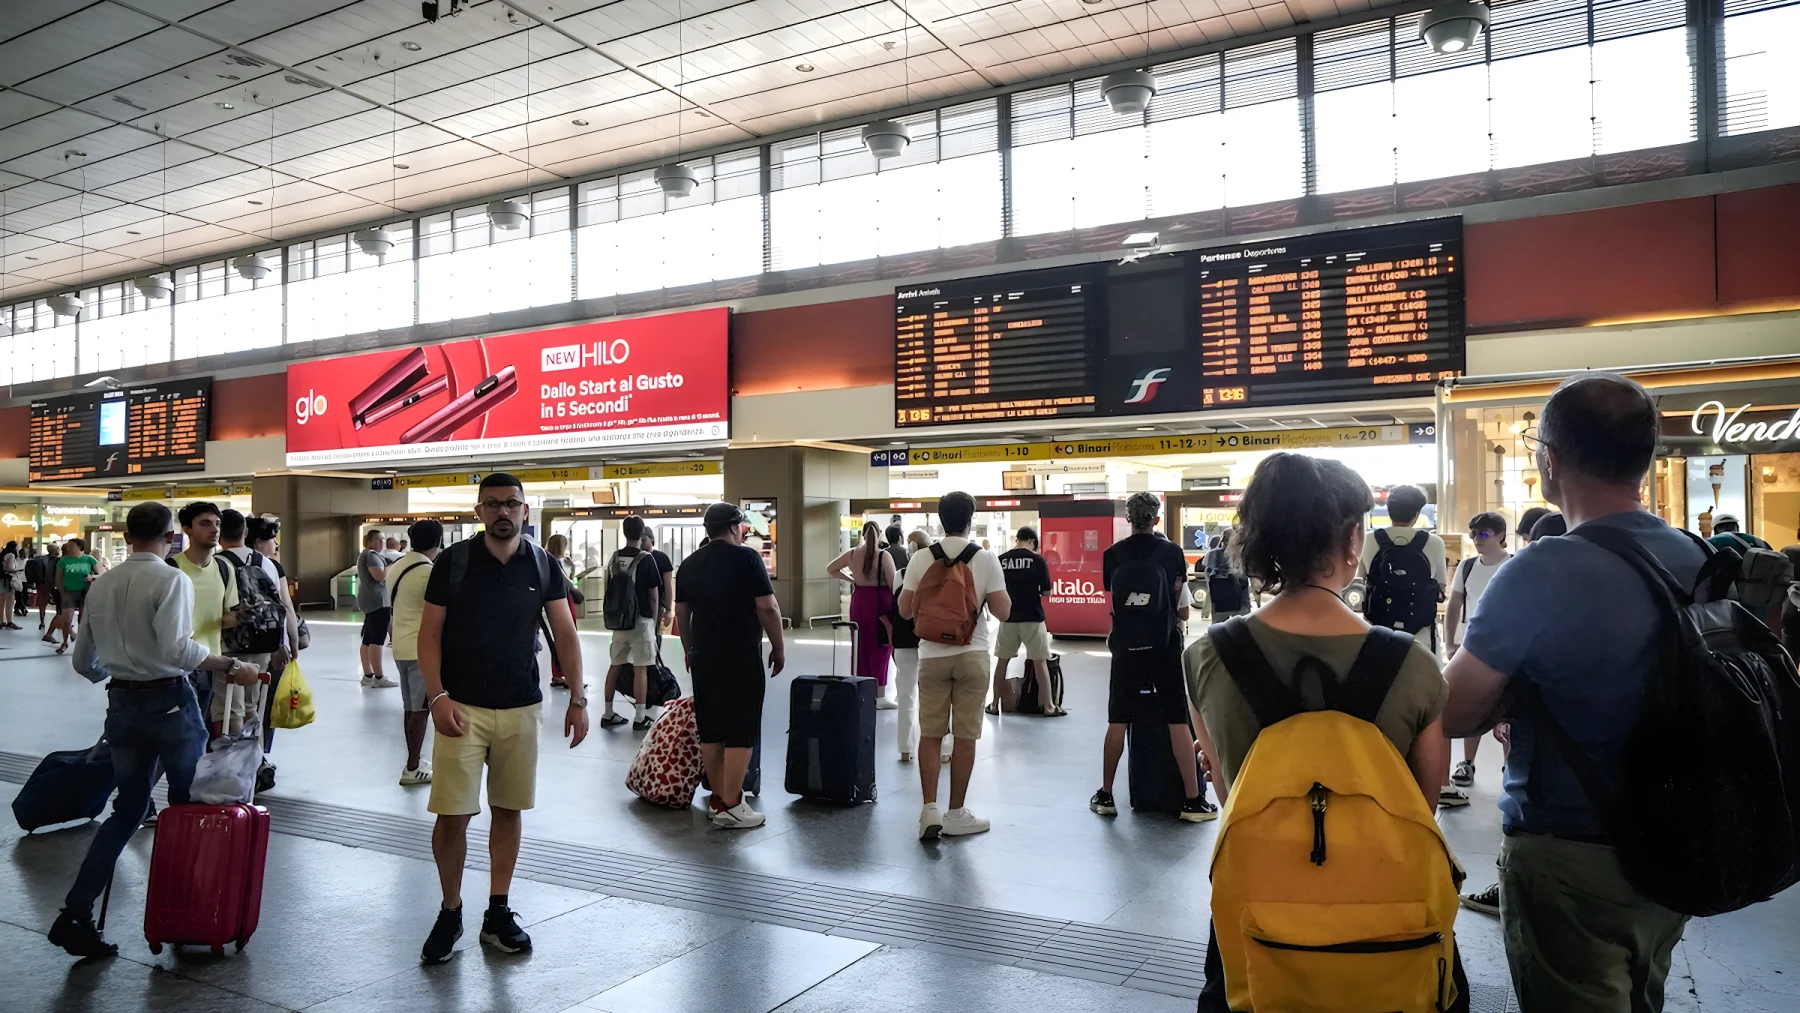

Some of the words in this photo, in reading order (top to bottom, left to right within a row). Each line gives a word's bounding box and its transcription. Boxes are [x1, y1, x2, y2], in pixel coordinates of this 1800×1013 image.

[545, 350, 576, 367] NEW
[582, 338, 630, 367] HILO
[541, 381, 576, 400] Dallo
[579, 376, 616, 396] Start
[619, 374, 633, 393] al
[636, 371, 684, 391] Gusto
[295, 388, 328, 425] glo
[541, 402, 554, 419] in
[556, 402, 566, 417] 5
[1077, 443, 1111, 453] Binari
[1242, 434, 1281, 446] Binari
[1004, 447, 1029, 456] 1-10
[1053, 578, 1095, 596] italo
